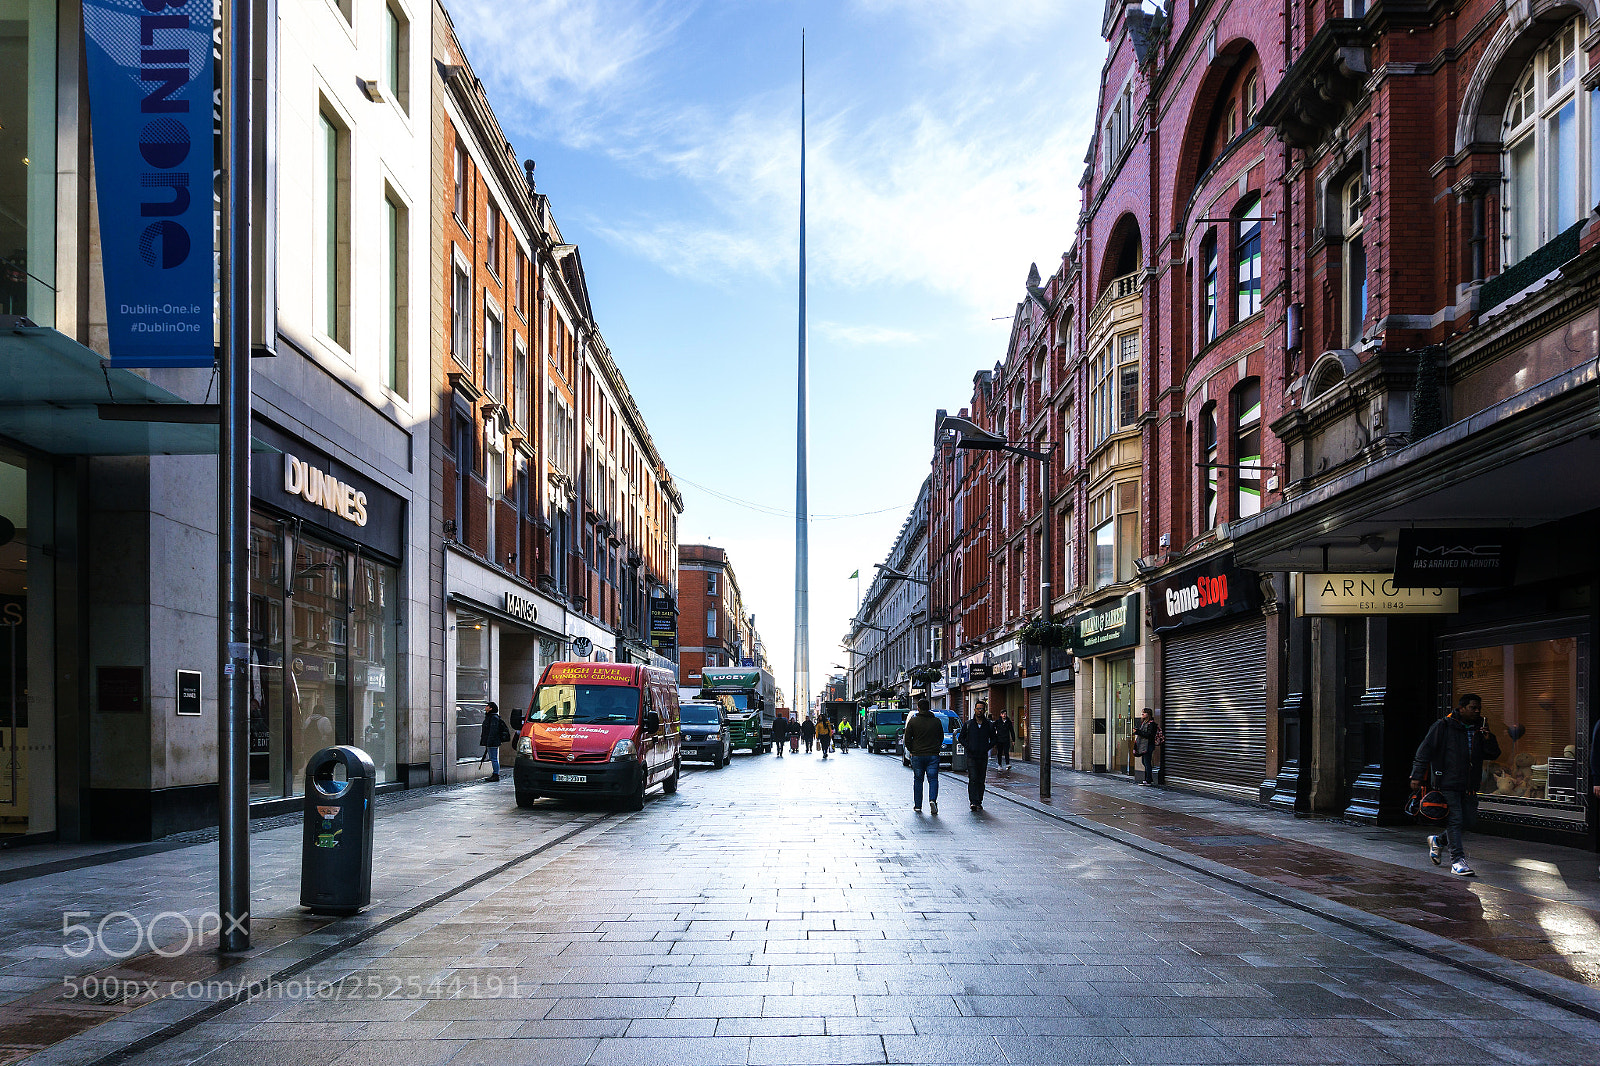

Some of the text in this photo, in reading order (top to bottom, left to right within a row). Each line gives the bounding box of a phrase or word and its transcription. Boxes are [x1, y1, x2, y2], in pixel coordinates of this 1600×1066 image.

[120, 304, 200, 314] Dublin-One.ie
[130, 322, 200, 332] #DublinOne
[284, 453, 368, 527] DUNNES
[1413, 559, 1500, 568] HAS ARRIVED IN ARNOTTS
[1166, 574, 1228, 617] GameStop
[504, 590, 538, 623] MANGO
[1459, 661, 1473, 669] YOUR
[1459, 671, 1473, 679] YOUR
